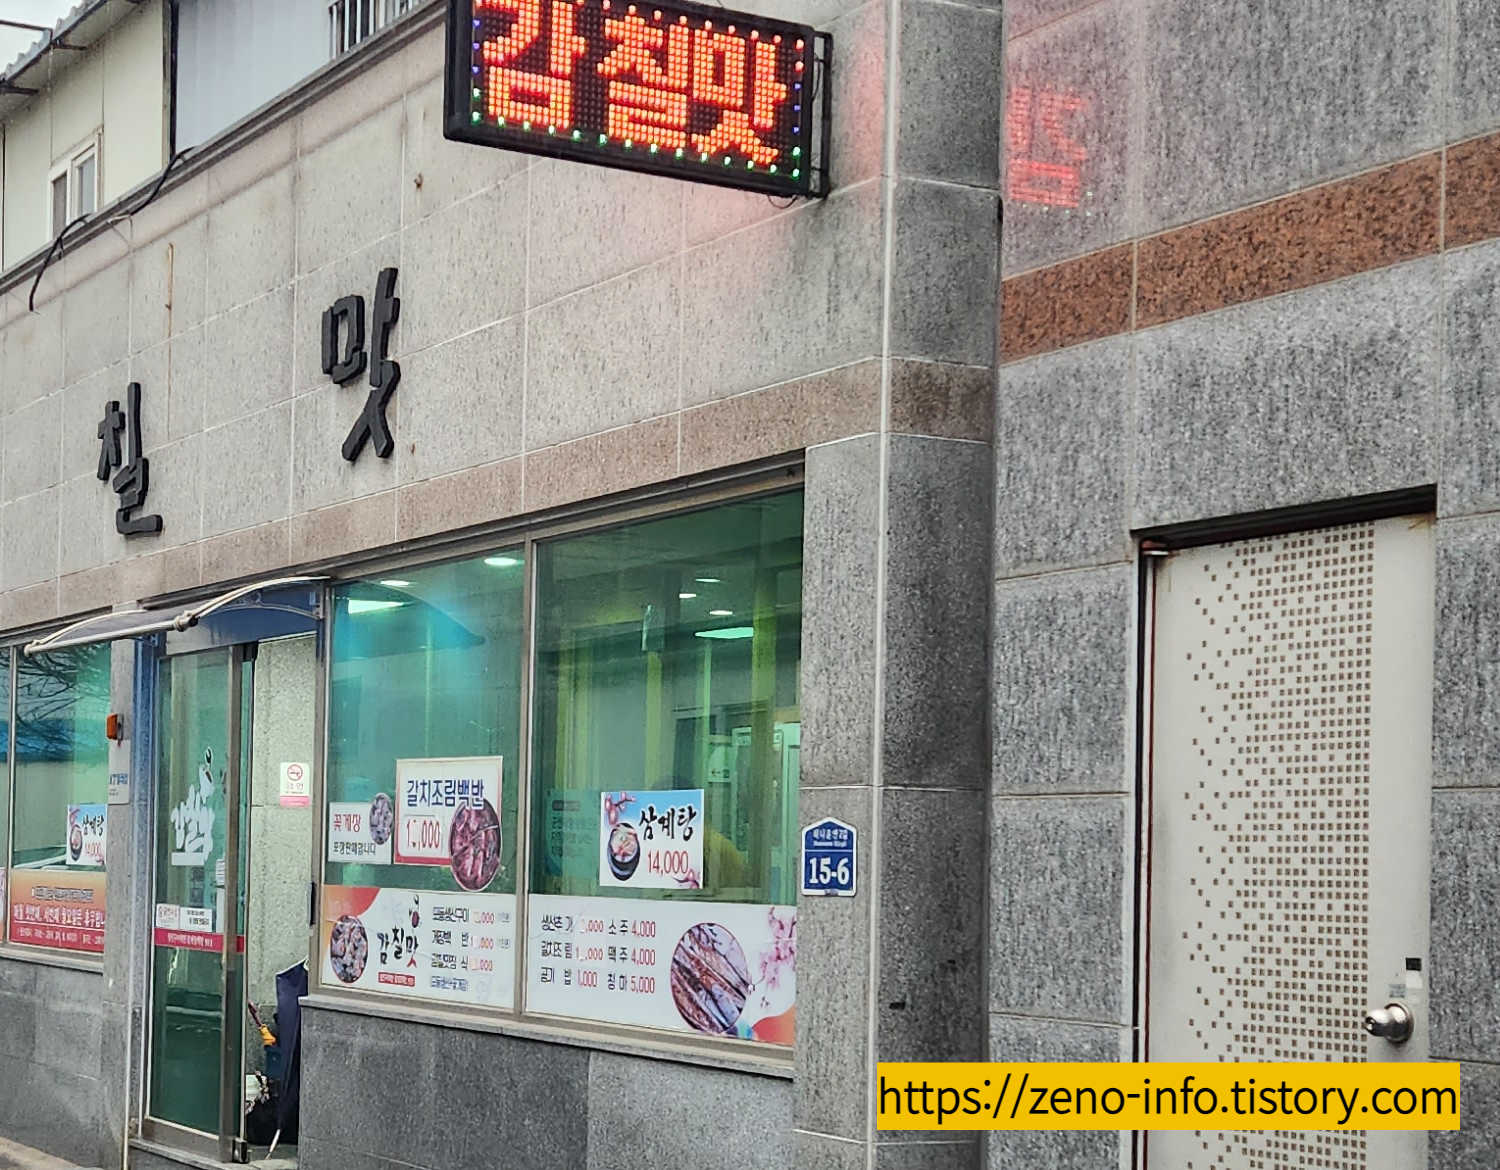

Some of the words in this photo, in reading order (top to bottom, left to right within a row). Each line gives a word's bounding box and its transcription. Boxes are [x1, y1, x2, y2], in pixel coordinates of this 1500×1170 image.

[476, 0, 788, 166] 감칠맛
[406, 778, 485, 809] 갈치조림백반
[332, 813, 362, 833] 꽃게장
[406, 818, 441, 851] 1,000
[639, 804, 697, 842] 삼계탕
[647, 850, 689, 877] 14,000
[809, 857, 850, 885] 15-6
[631, 920, 656, 938] 4,000
[377, 925, 419, 968] 감칠맛
[576, 947, 604, 962] 1,000
[631, 948, 656, 966] 4,000
[577, 969, 598, 988] 1,000
[631, 975, 655, 994] 5,000
